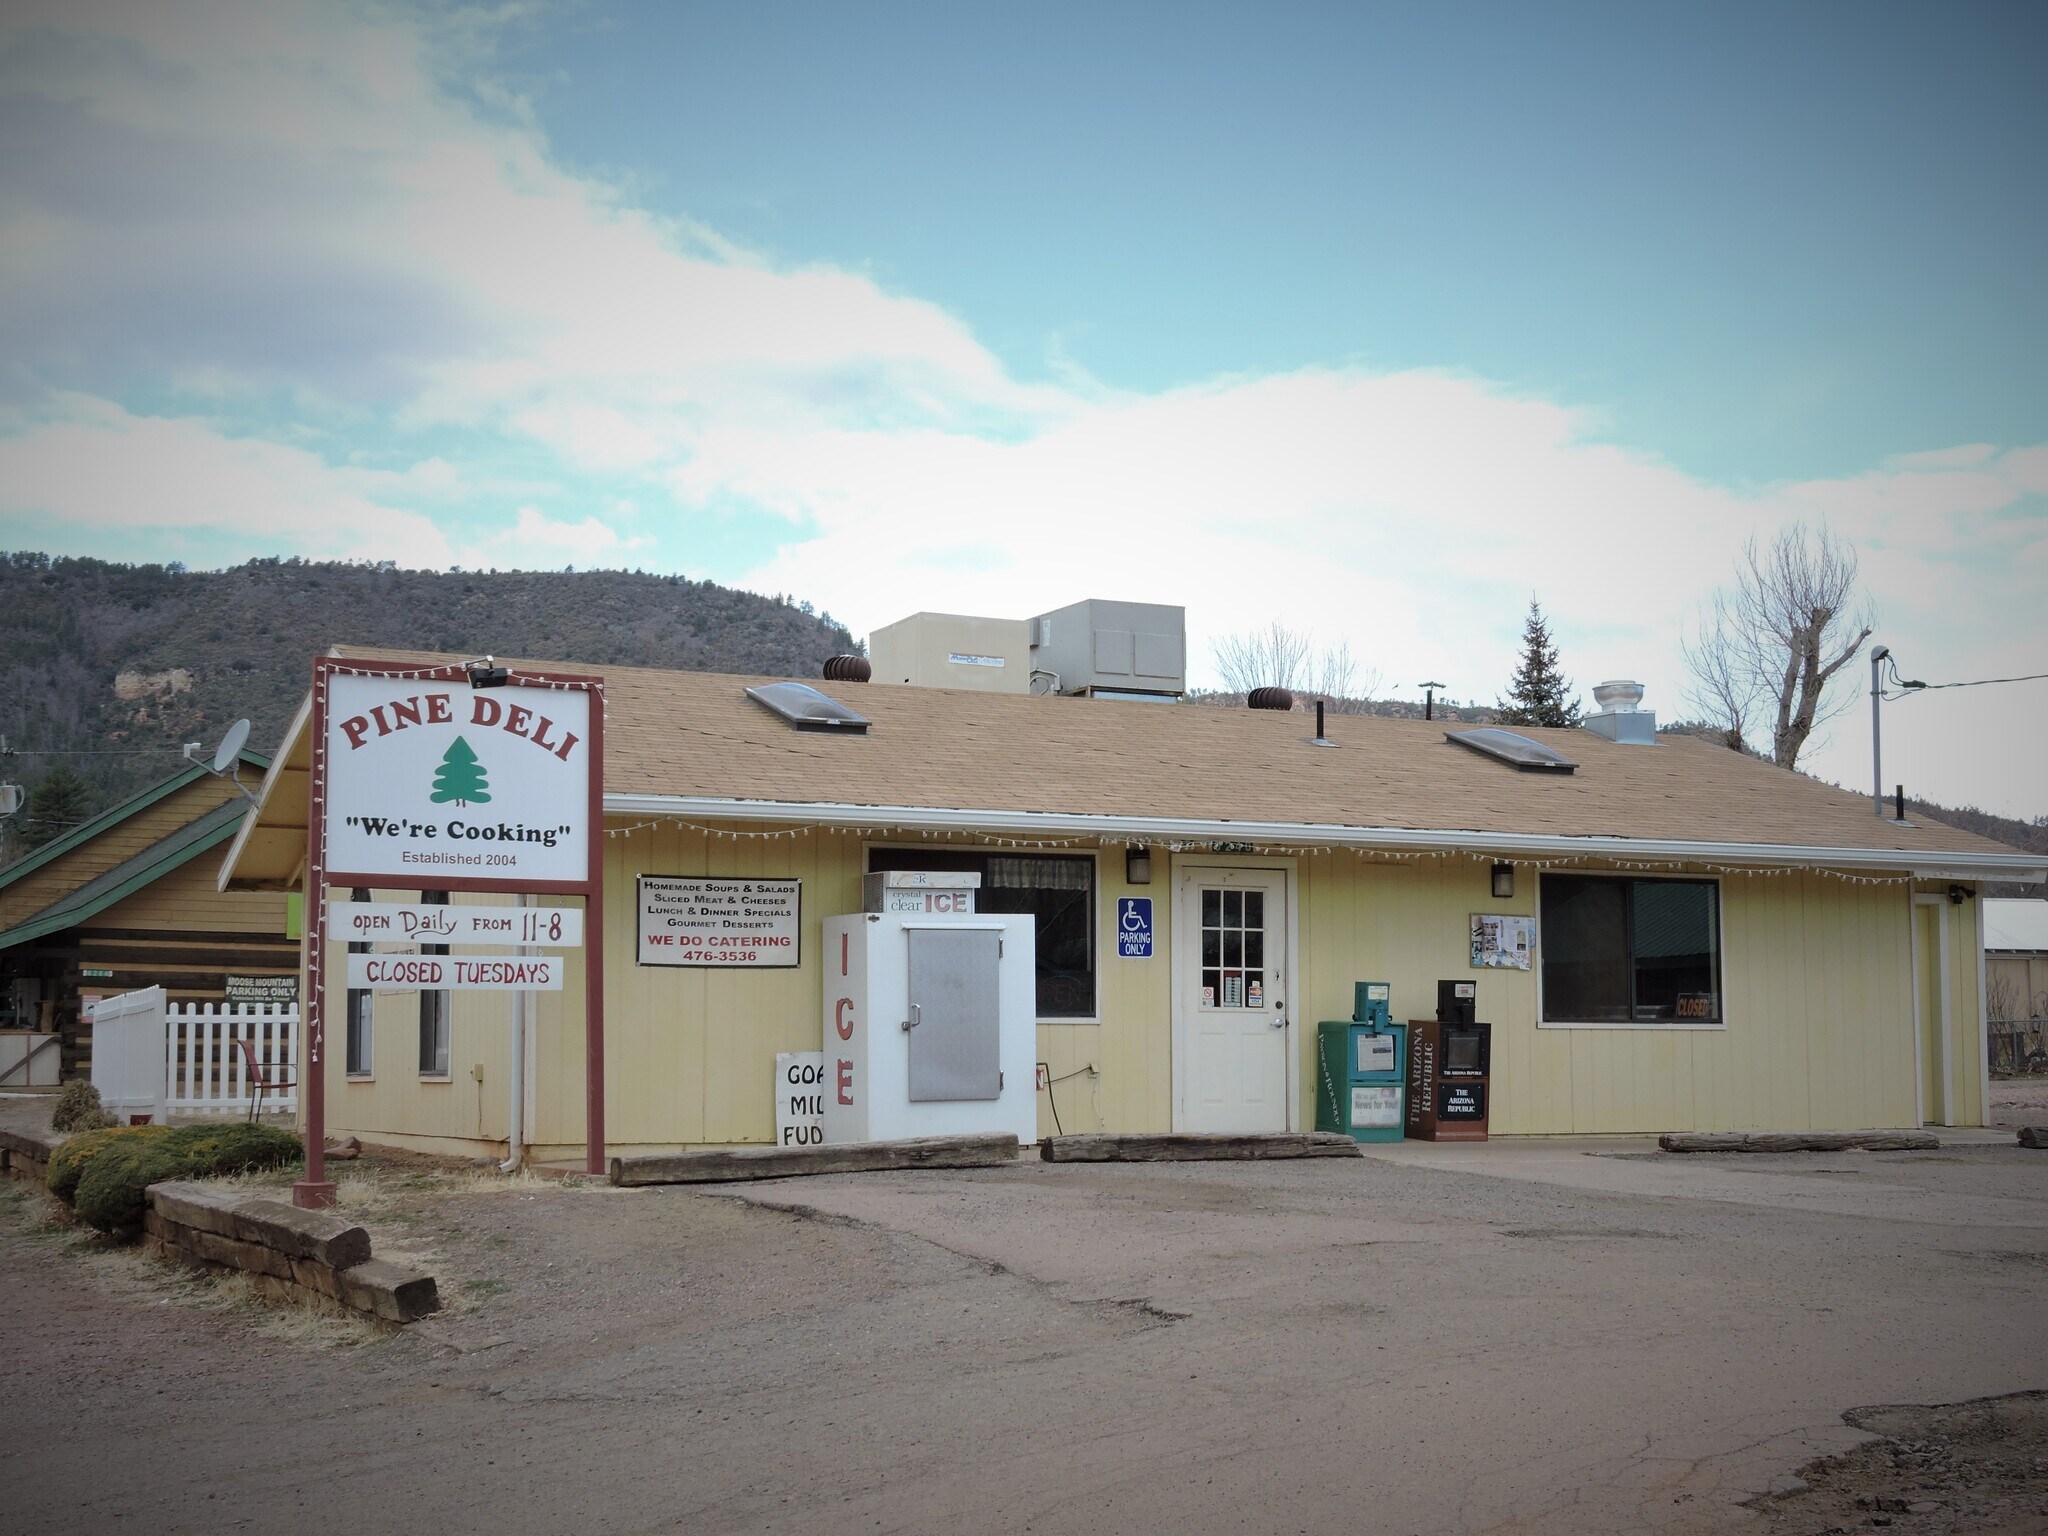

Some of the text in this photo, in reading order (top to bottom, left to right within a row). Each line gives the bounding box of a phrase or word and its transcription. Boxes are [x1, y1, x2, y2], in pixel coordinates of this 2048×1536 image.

[339, 693, 579, 762] PINE DELI
[346, 816, 571, 848] "We're Cooking"
[402, 851, 517, 866] Established 2004
[705, 884, 739, 893] SOUPS
[743, 885, 752, 893] &
[757, 885, 795, 893] SALADS
[654, 893, 786, 905] SLICED MEAT & CHEESES
[891, 899, 922, 911] clear
[925, 893, 967, 913] ICE
[647, 906, 792, 917] LUNCH & DINNER SPECIALS
[353, 909, 562, 942] OPEN Daily FROM 11-8
[667, 918, 774, 928] GOURMET DESSERTS
[648, 935, 791, 947] WE DO CATERING
[1119, 932, 1151, 943] PARKING
[1125, 943, 1145, 955] ONLY
[683, 950, 757, 961] 476-3536
[366, 960, 550, 984] CLOSED TUESDAYS
[228, 977, 295, 987] MOOSE MOUNTAIN
[226, 986, 297, 997] PARKING ONLY
[1677, 998, 1709, 1017] CLOSED
[836, 932, 854, 1105] ICE
[1410, 1027, 1423, 1125] THE ARIZONA
[1422, 1043, 1433, 1112] REPUBLIC
[1455, 1088, 1468, 1096] THE
[1447, 1105, 1475, 1113] REPUBLIC
